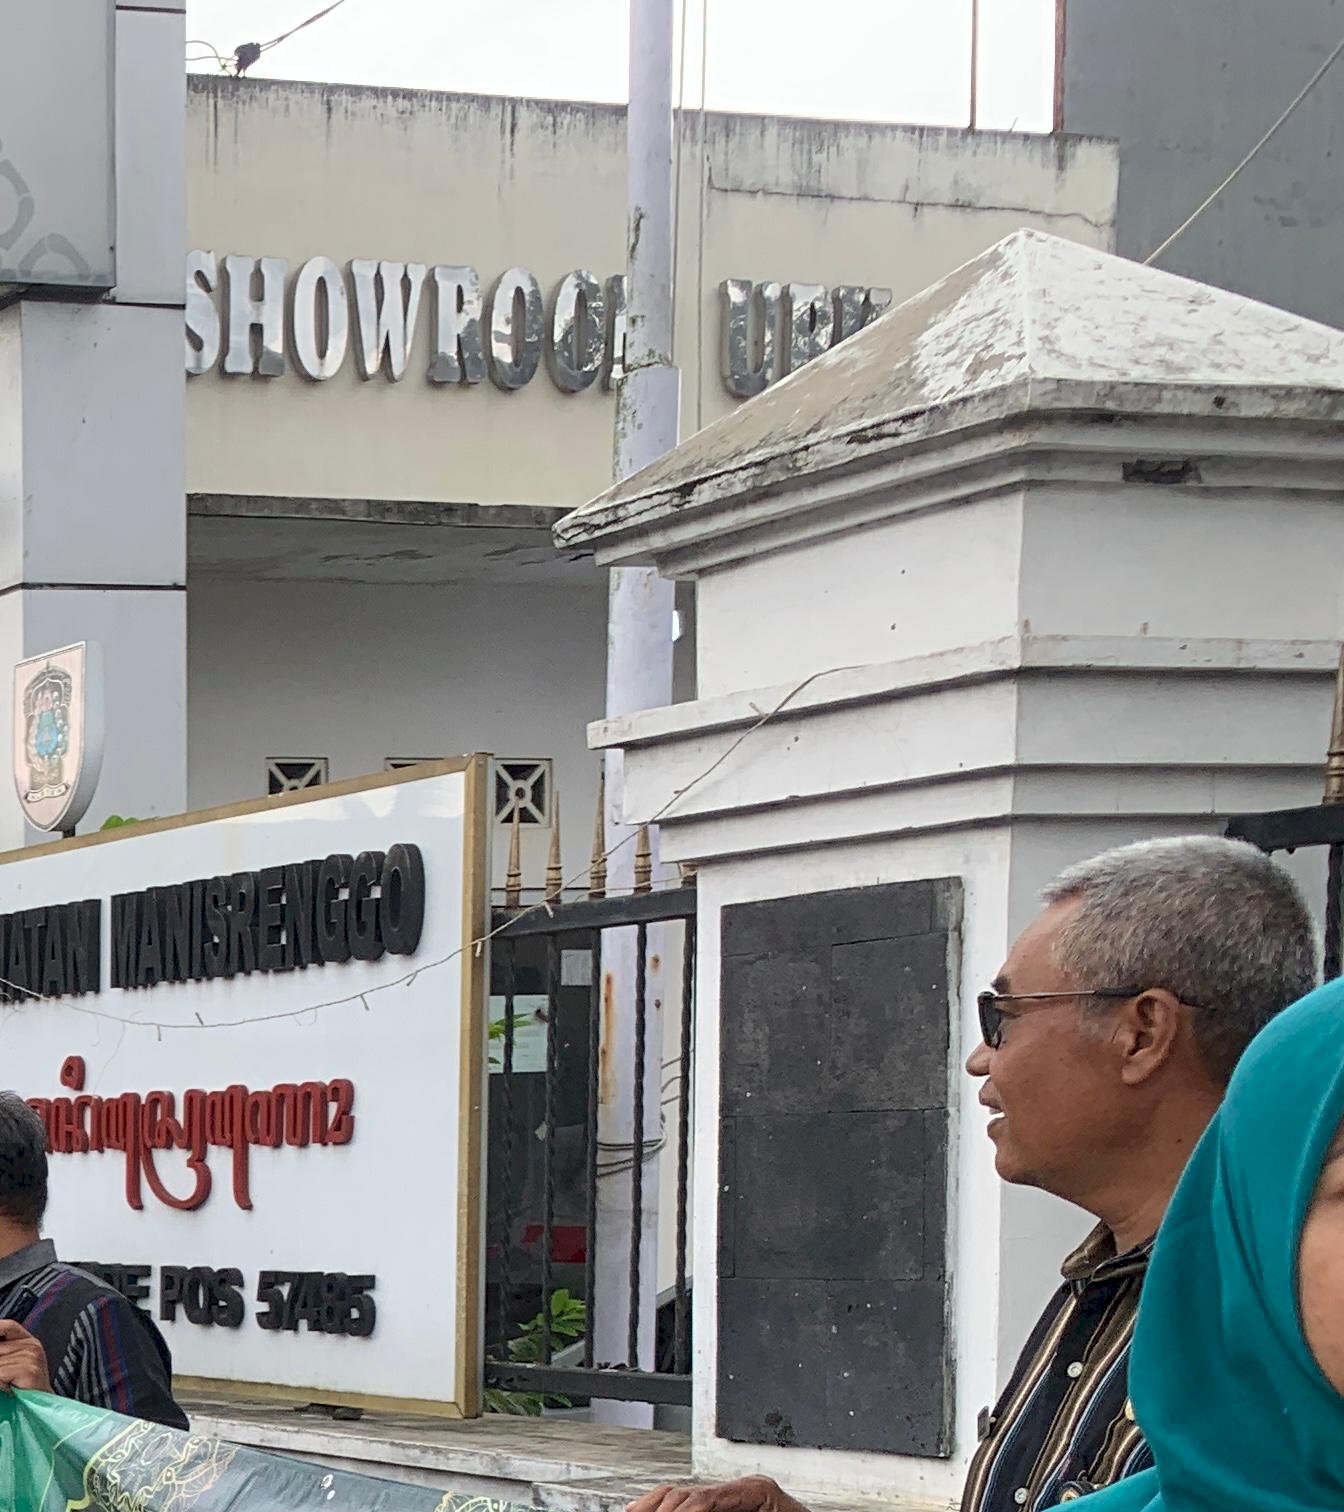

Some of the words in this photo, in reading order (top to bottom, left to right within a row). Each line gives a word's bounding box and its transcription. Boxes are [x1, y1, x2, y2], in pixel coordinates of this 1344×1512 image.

[110, 843, 425, 989] MANISRENGGO
[160, 1266, 245, 1329] POS
[256, 1269, 376, 1337] 57485
